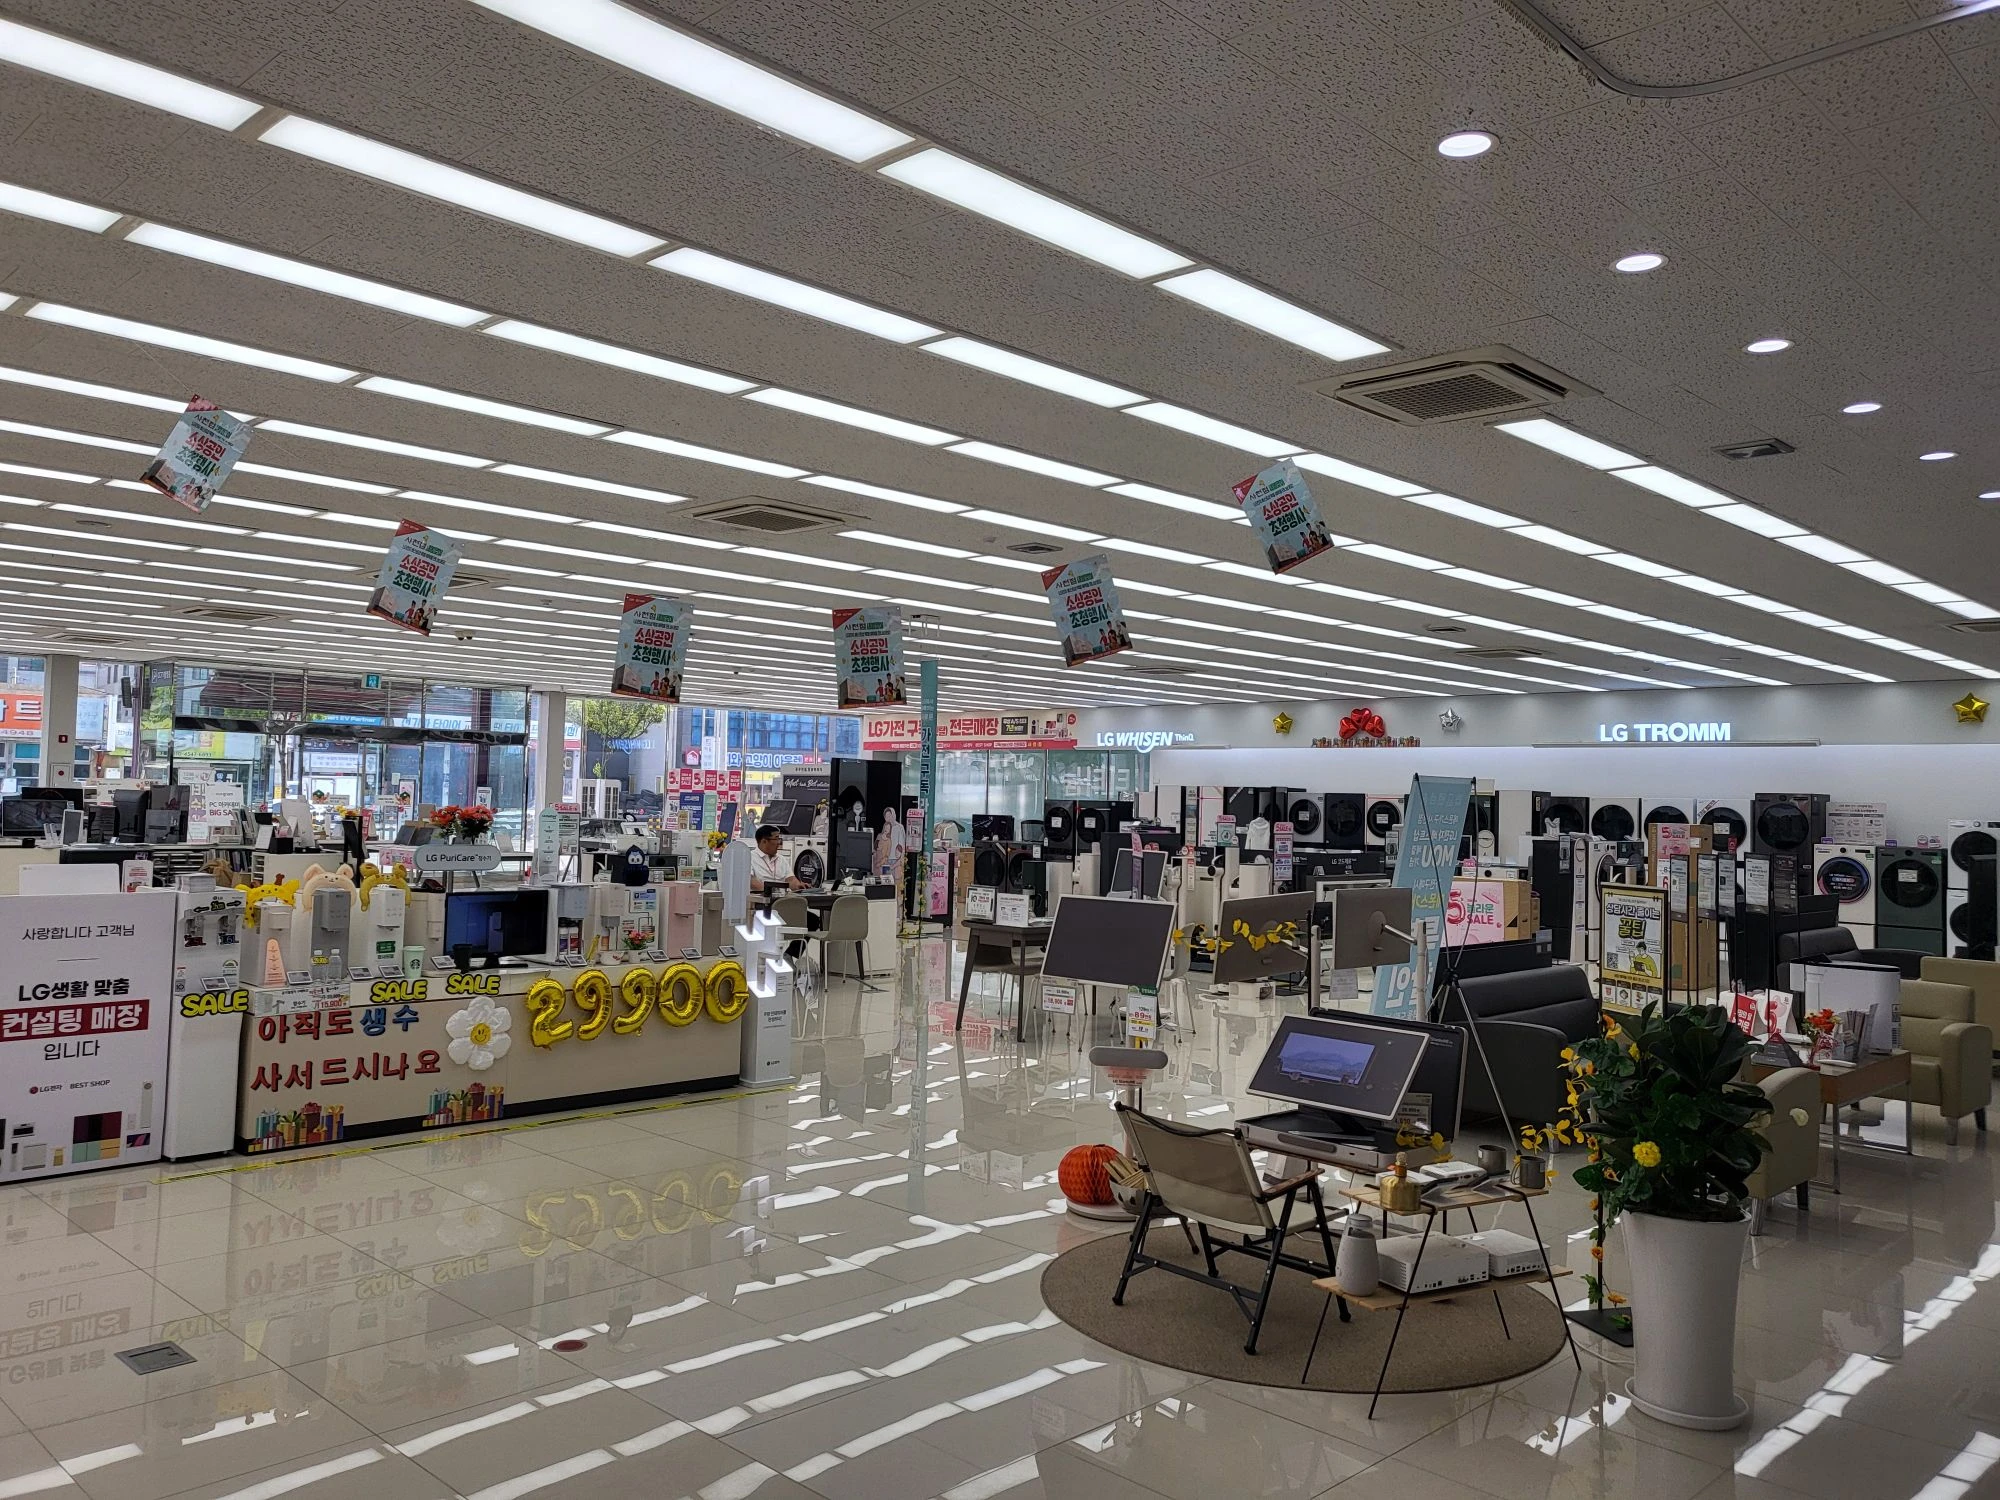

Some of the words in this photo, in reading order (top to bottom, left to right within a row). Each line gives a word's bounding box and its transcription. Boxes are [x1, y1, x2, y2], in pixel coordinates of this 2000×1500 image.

[185, 431, 227, 462] 소상공인
[175, 445, 216, 477] 초청행사
[1262, 491, 1299, 521] 소상공인
[1268, 507, 1307, 537] 초청행사
[400, 554, 440, 580] 소상공인
[392, 570, 432, 597] 초청행사
[1066, 587, 1104, 612] 소상공인
[1069, 603, 1109, 629] 초청행사
[634, 627, 674, 648] 소상공인
[850, 637, 889, 656] 소상공인
[631, 644, 671, 666] 초청행사
[851, 655, 890, 673] 초청행사
[868, 720, 905, 738] LG가전
[950, 717, 1000, 736] 전문매장
[1600, 723, 1628, 742] LG
[1634, 722, 1731, 742] TROMM
[1097, 732, 1114, 747] LG
[1116, 731, 1174, 754] WHISEN
[1174, 733, 1195, 742] ThinQ
[745, 753, 772, 769] 고양이
[209, 809, 222, 817] BIG
[425, 854, 438, 862] LG
[440, 853, 476, 862] PuriCare
[1446, 889, 1466, 925] 5
[1606, 902, 1636, 918] 상담시간
[1467, 914, 1495, 925] SALE
[1618, 917, 1647, 940] 꿀팁
[22, 925, 92, 942] 사랑합니다
[95, 923, 136, 938] 고객님
[18, 979, 91, 1002] LG생활
[93, 976, 131, 997] 맞춤
[369, 979, 429, 1004] SALE
[446, 972, 502, 995] SALE
[180, 988, 250, 1018] SALE
[526, 960, 750, 1049] 29900
[1, 1007, 84, 1038] 컨설팅
[90, 1004, 143, 1029] 매장
[258, 1010, 355, 1043] 아직도
[359, 1005, 420, 1037] 생수
[1764, 1000, 1779, 1034] 5
[43, 1039, 101, 1061] 입니다
[39, 1083, 63, 1094] LG전자
[69, 1080, 89, 1091] BEST
[89, 1078, 111, 1089] SHOP
